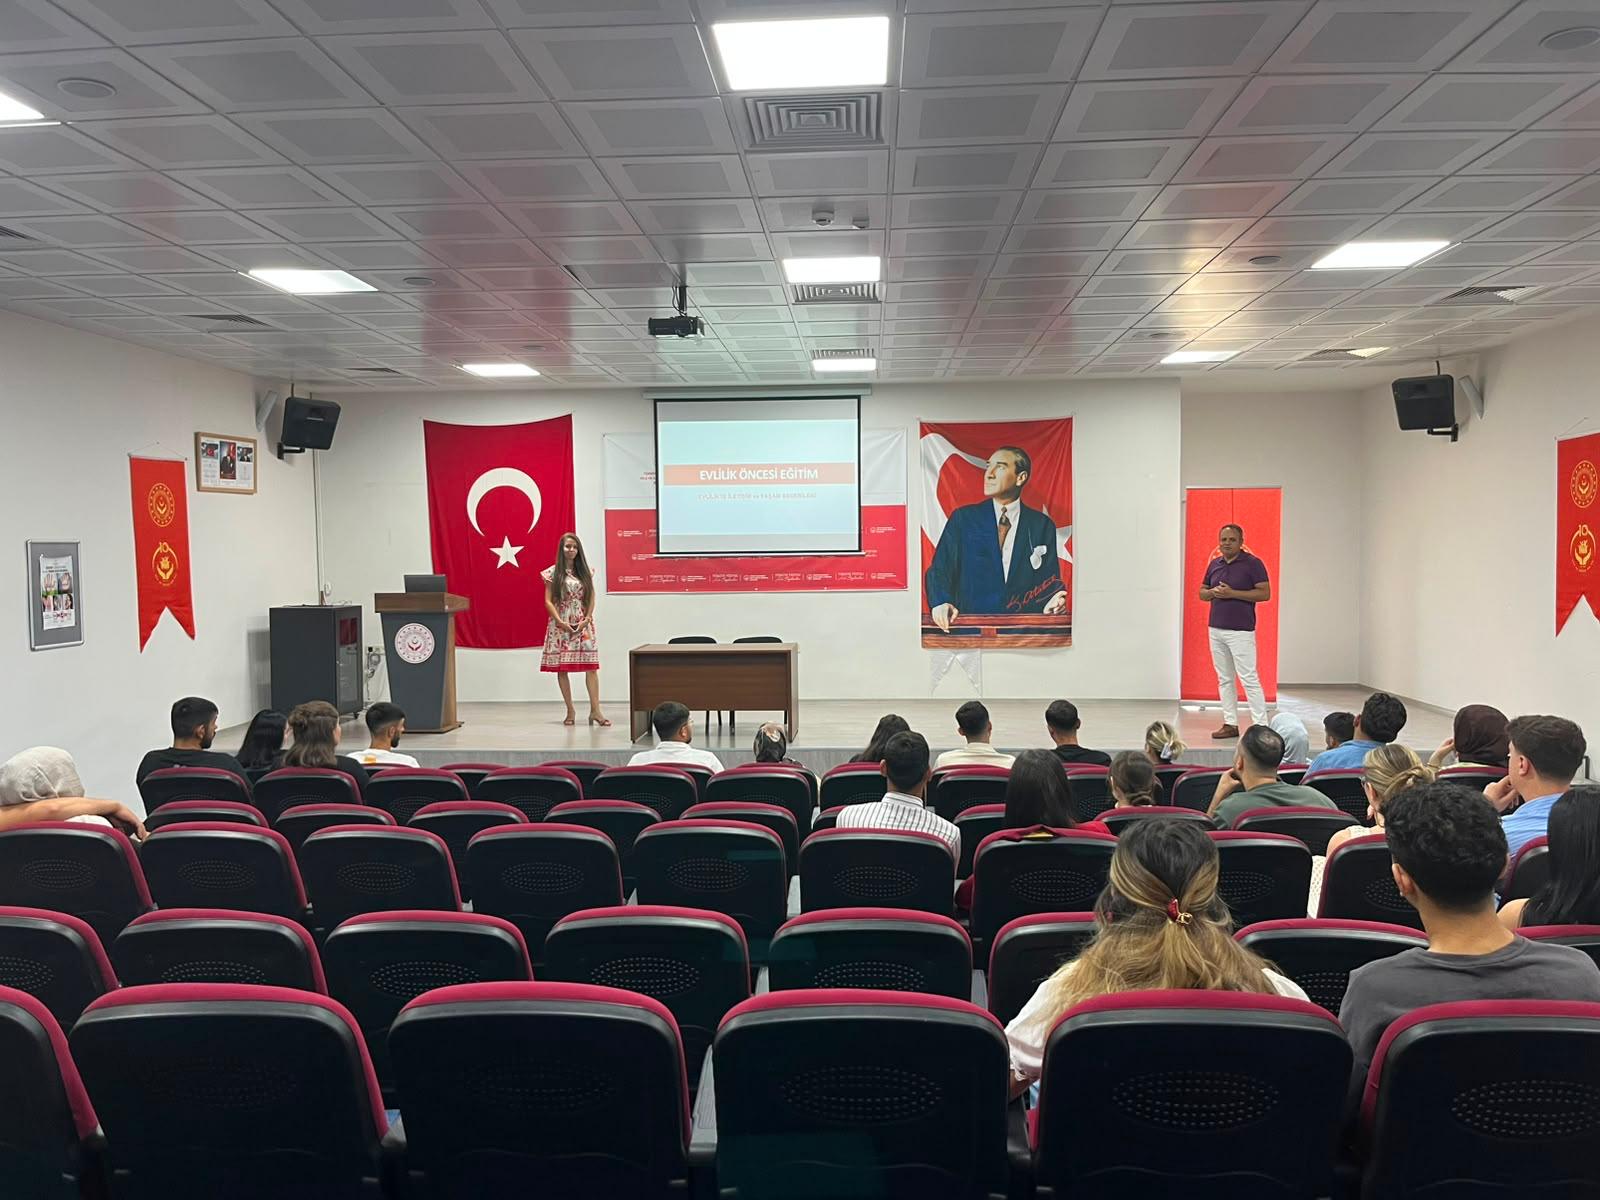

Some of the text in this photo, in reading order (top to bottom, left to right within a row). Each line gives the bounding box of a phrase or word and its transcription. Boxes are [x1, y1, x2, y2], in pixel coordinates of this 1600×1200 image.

[699, 466, 819, 481] EVLİLİK ÖNCESİ EĞİTİM
